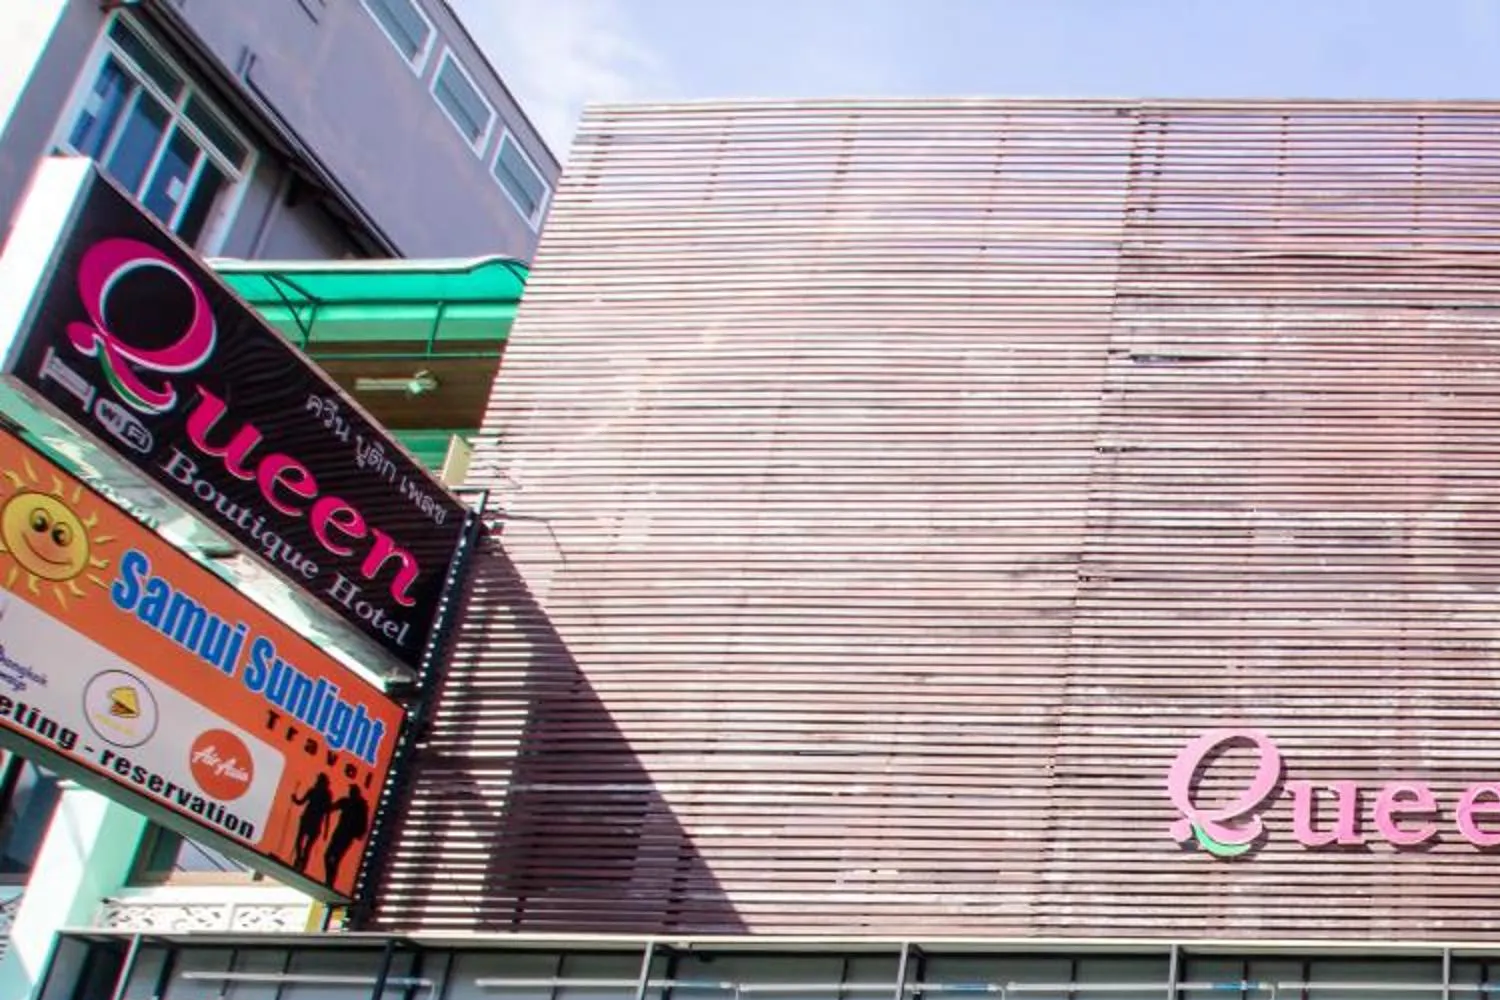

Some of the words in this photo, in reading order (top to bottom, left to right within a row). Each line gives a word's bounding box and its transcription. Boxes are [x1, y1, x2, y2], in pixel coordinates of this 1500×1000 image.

[66, 238, 416, 606] Queen
[162, 446, 320, 580] Boutique
[326, 571, 410, 646] Hotel
[111, 548, 249, 677] Samui
[244, 634, 386, 766] Sunlight
[266, 709, 373, 789] Travel
[101, 749, 255, 839] reservation
